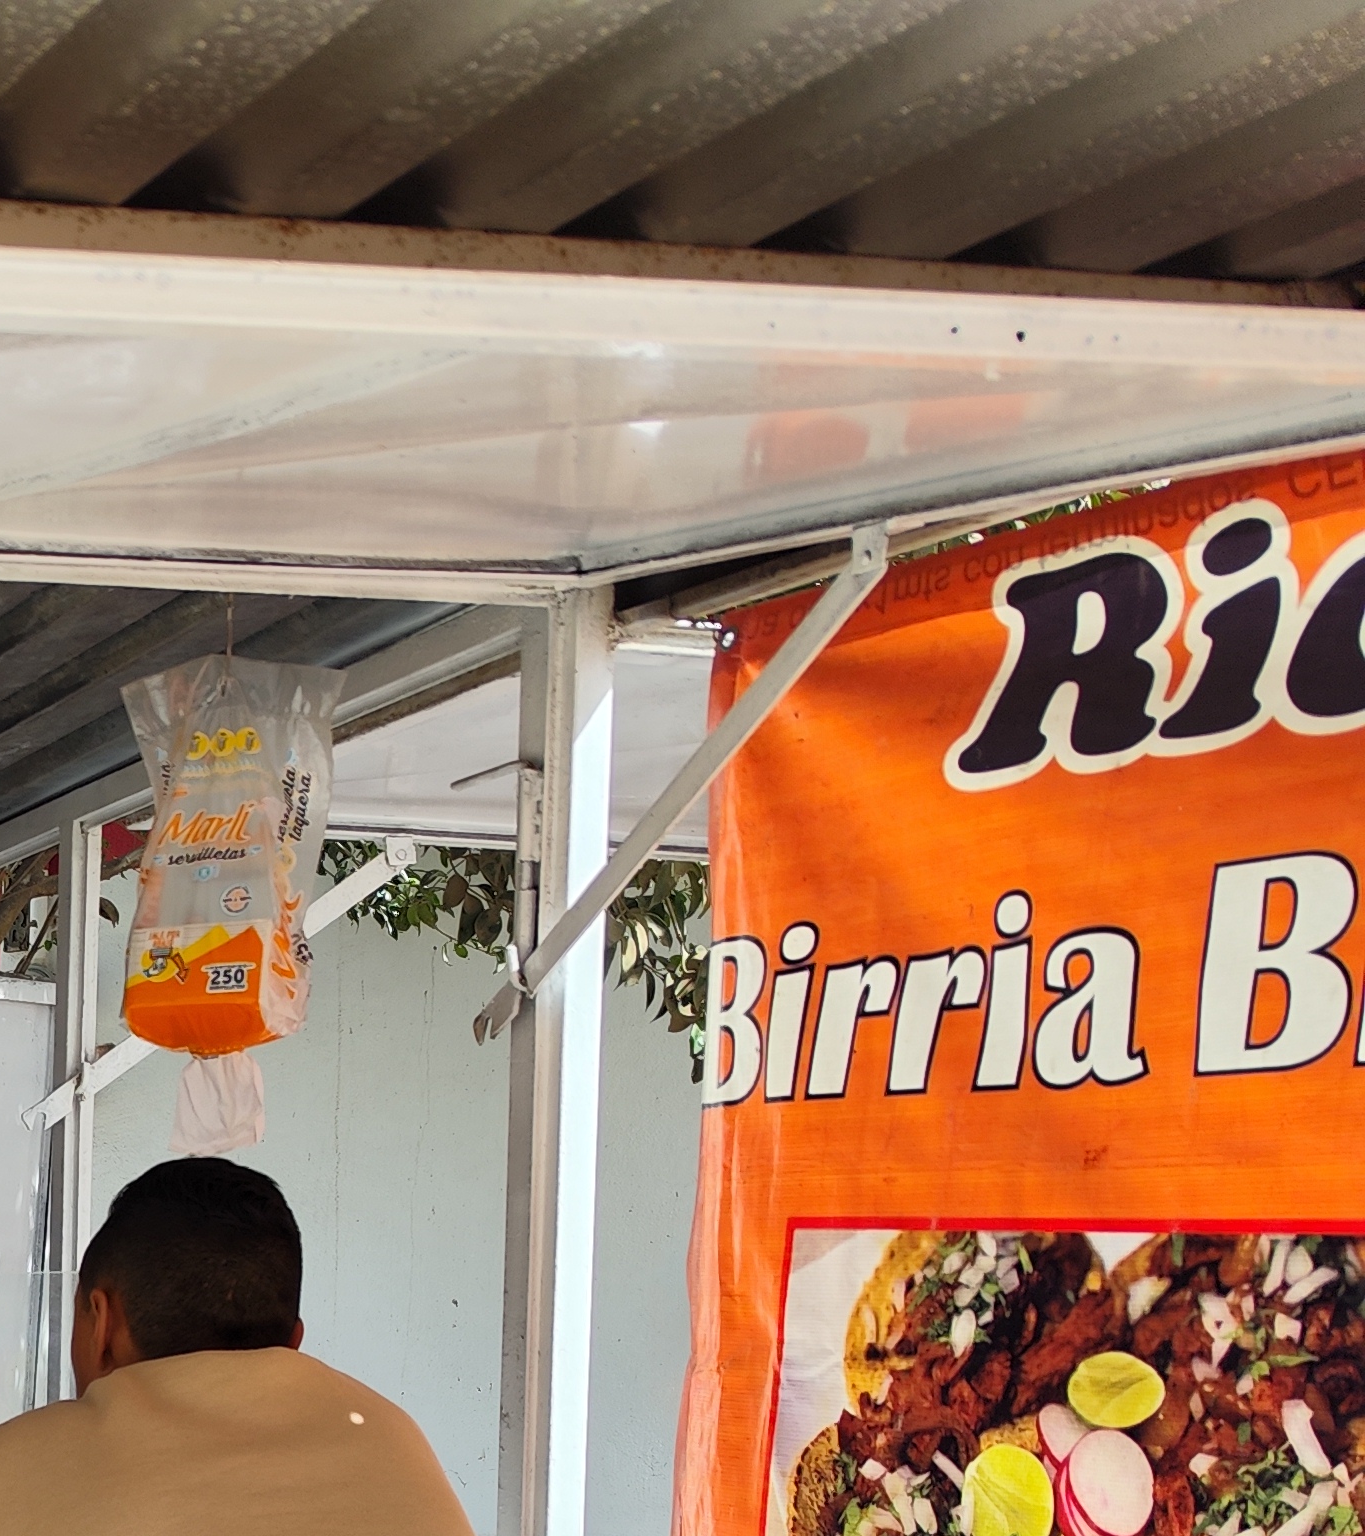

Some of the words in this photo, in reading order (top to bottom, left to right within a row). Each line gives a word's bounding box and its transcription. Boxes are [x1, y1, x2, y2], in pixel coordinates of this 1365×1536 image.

[158, 799, 256, 847] Marli
[211, 968, 245, 985] 250
[701, 890, 1149, 1107] Birria
[1193, 850, 1365, 1077] B
